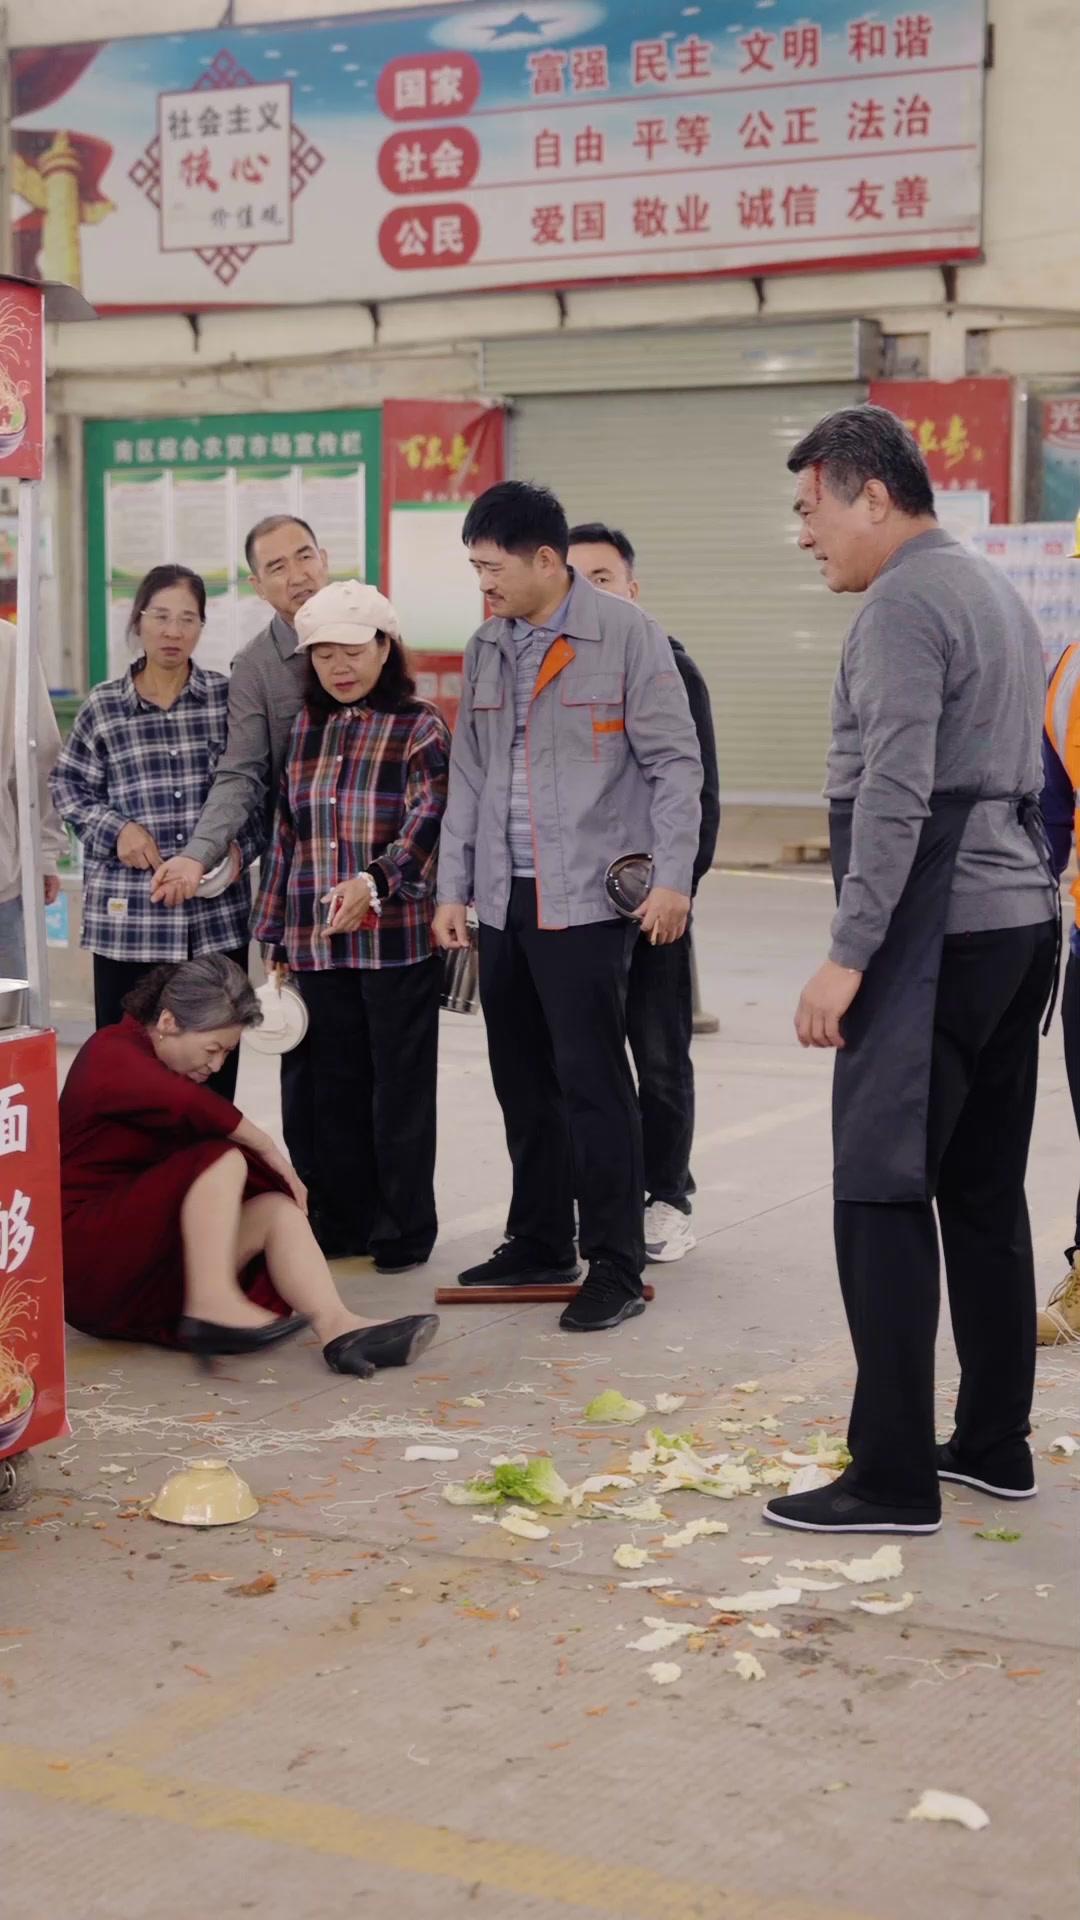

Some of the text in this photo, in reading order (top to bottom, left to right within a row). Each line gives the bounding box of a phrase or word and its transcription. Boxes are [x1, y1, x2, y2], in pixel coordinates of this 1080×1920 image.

[529, 14, 934, 95] 富强 民主 文明 和谐
[394, 65, 464, 110] 国家
[168, 102, 282, 141] 社会主义
[534, 94, 932, 169] 自由 平等 公正 法治
[180, 147, 270, 193] 核心
[394, 139, 465, 183] 社会
[210, 203, 284, 230] 价值观
[531, 175, 930, 246] 爱国 敬业 诚信 友善
[395, 215, 465, 257] 公民
